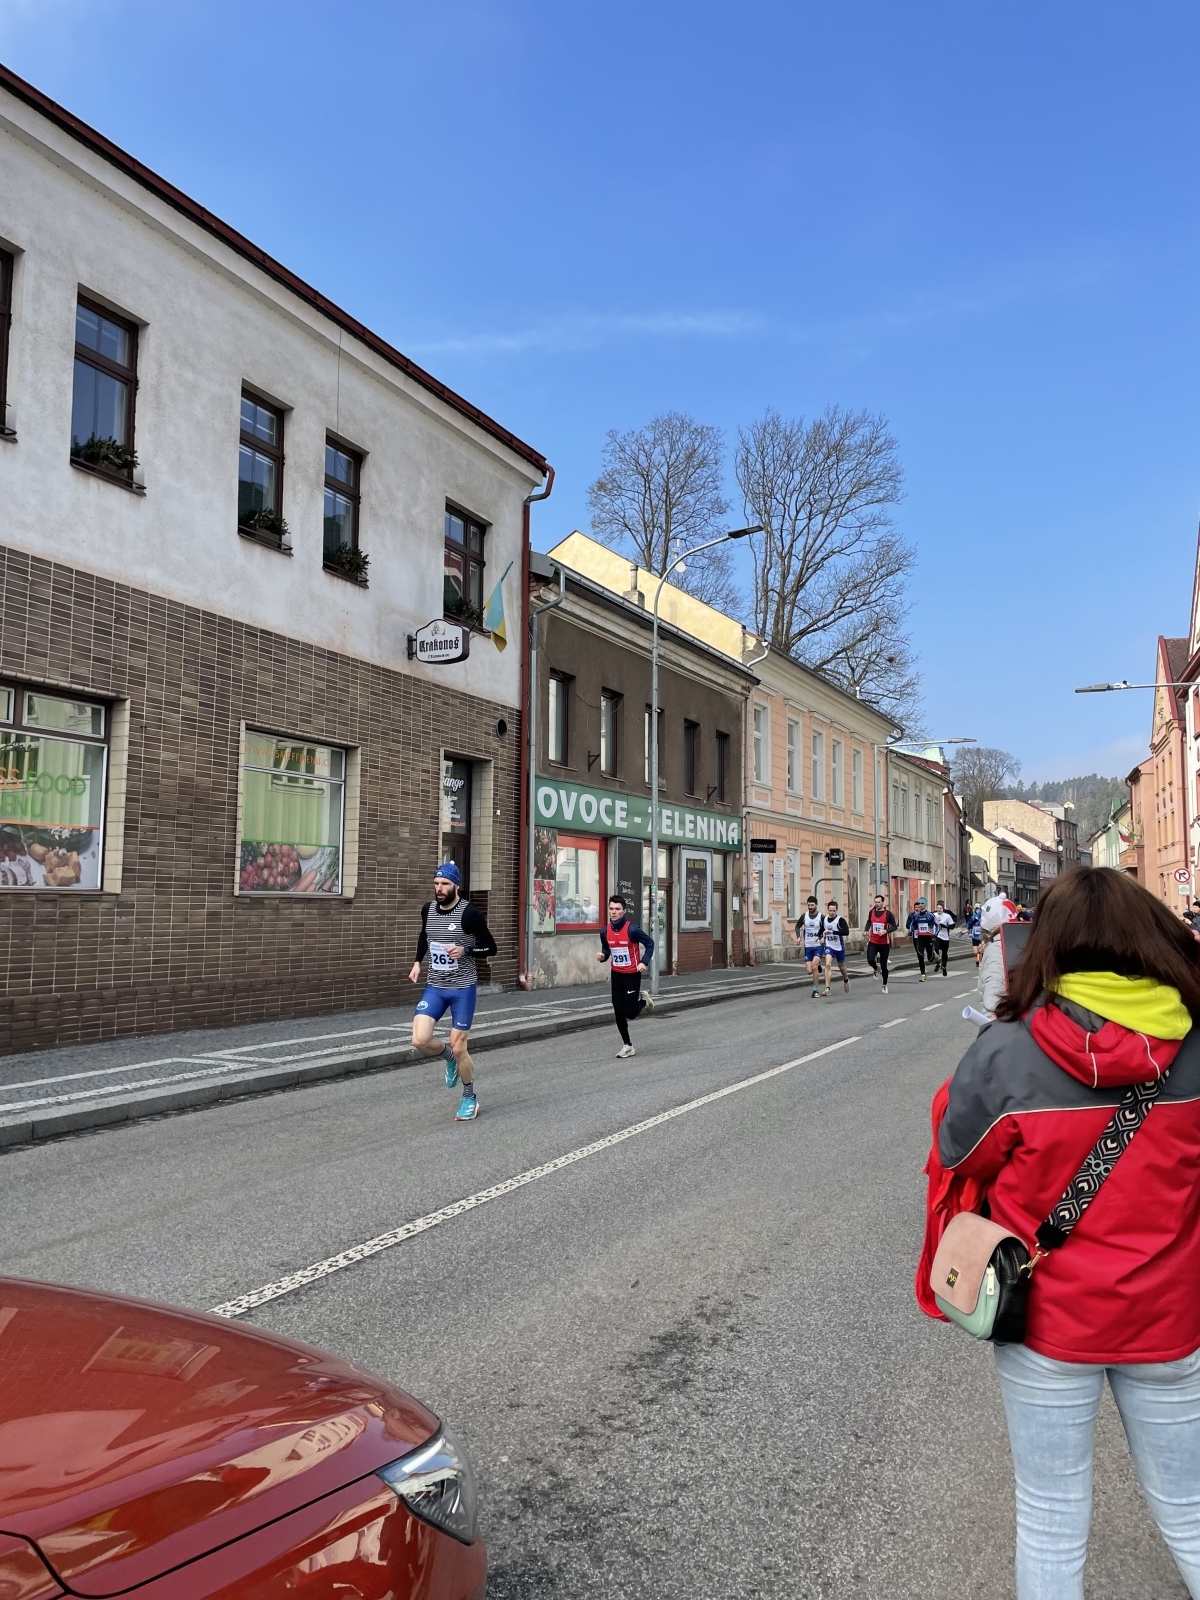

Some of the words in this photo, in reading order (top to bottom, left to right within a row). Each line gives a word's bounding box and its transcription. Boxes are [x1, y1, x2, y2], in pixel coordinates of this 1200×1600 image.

[419, 636, 460, 653] Krakonoš
[26, 770, 87, 797] FOOD
[537, 786, 629, 829] OVOCE
[432, 953, 455, 965] 263
[613, 954, 628, 963] 291
